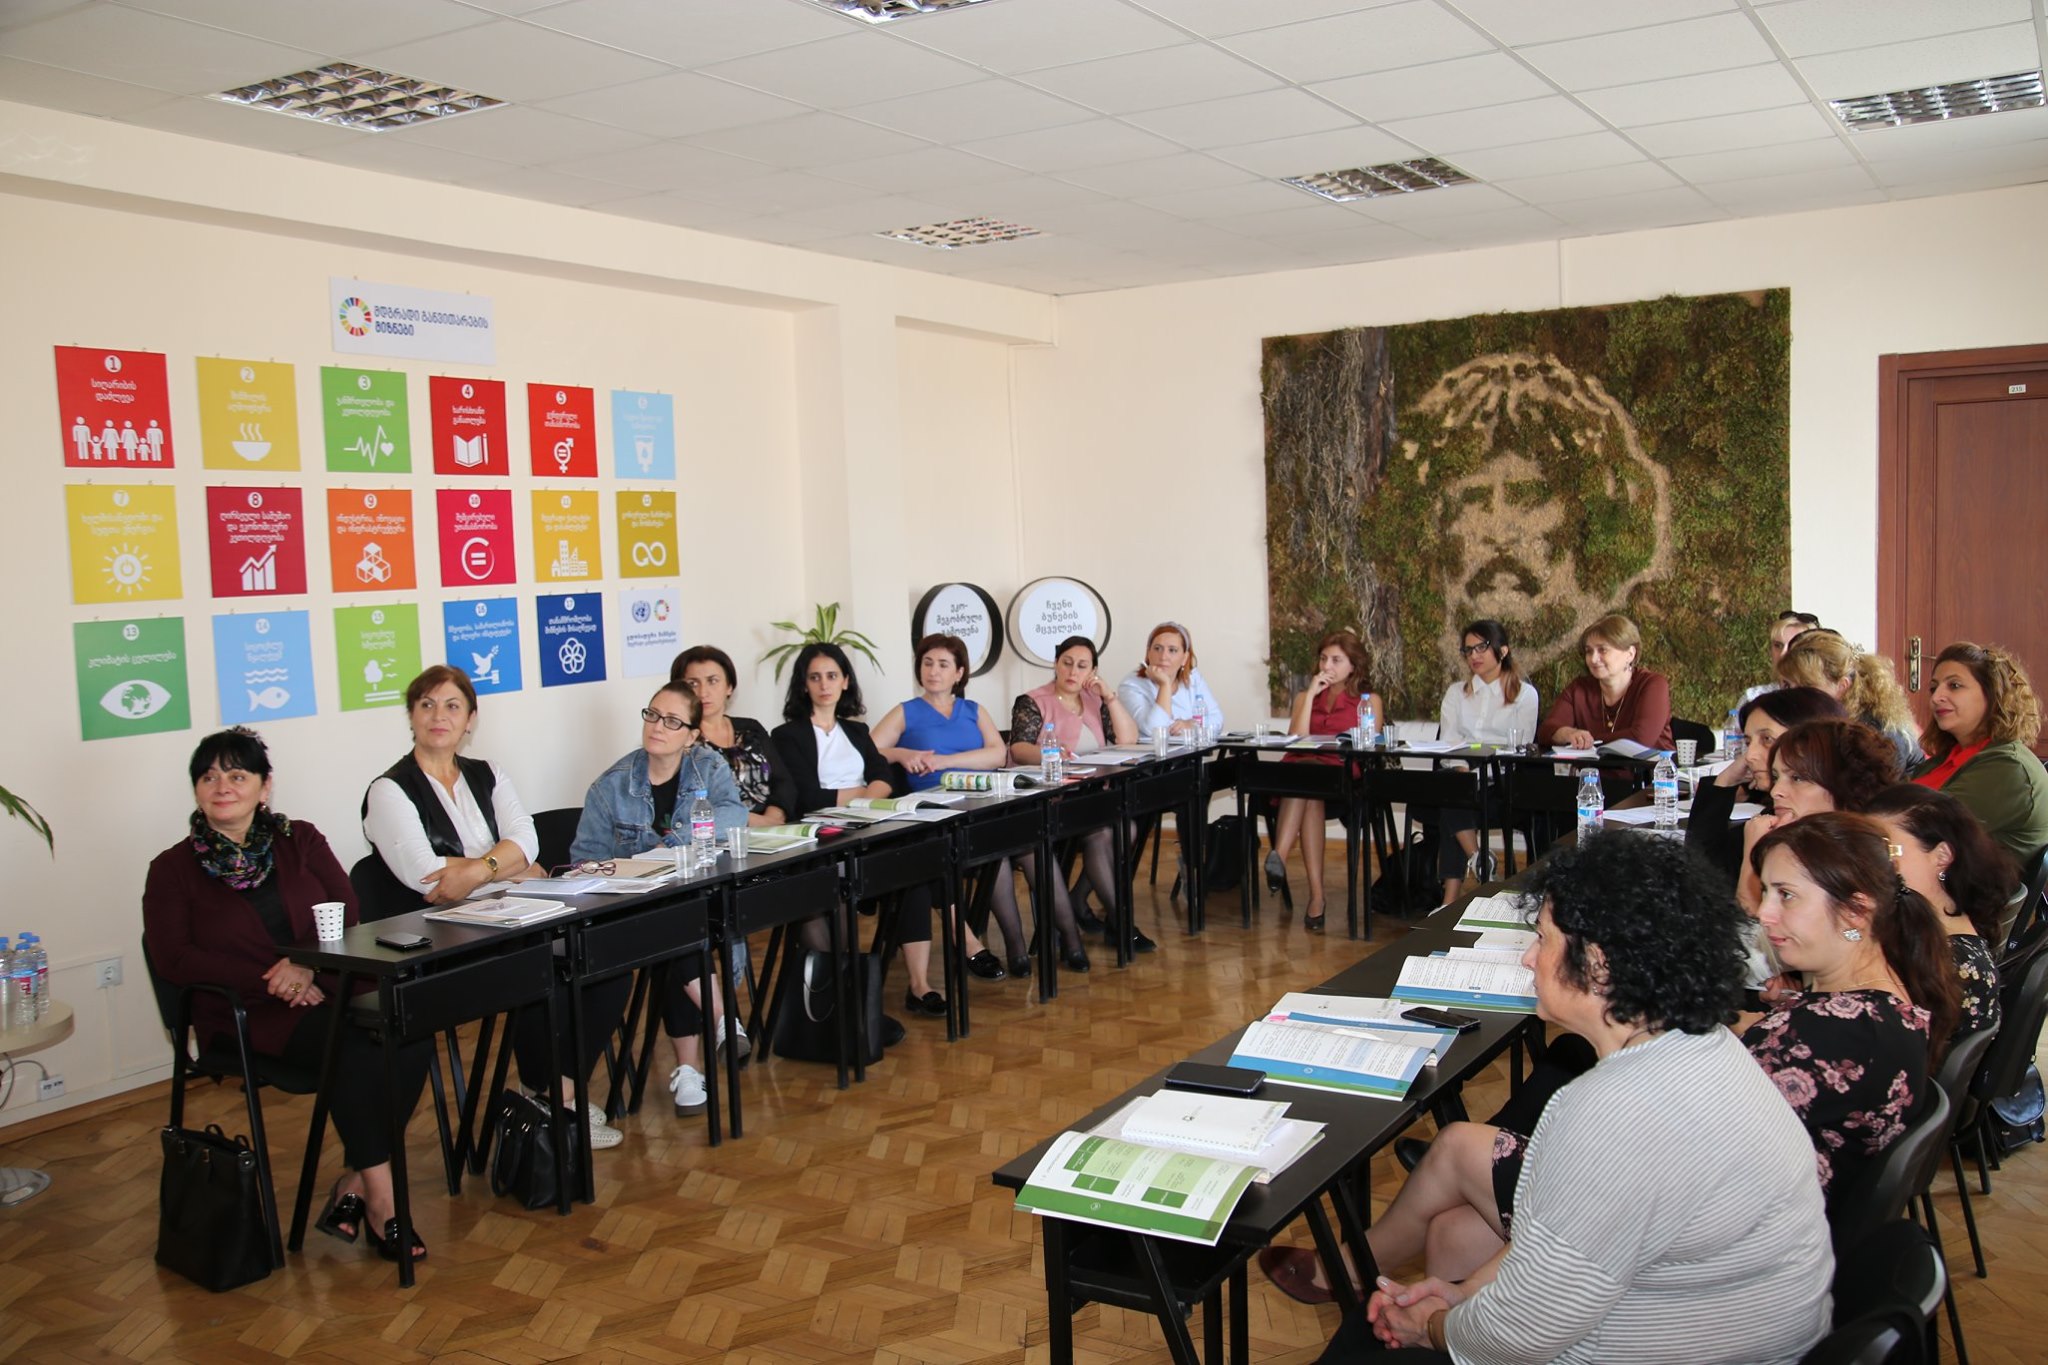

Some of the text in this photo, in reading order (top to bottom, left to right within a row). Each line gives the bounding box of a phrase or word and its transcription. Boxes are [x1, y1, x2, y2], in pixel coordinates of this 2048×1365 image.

[375, 320, 415, 336] მიზნები
[1045, 599, 1073, 610] ჩვენი
[1041, 610, 1079, 621] ბუნების
[1034, 623, 1083, 634] მცველები
